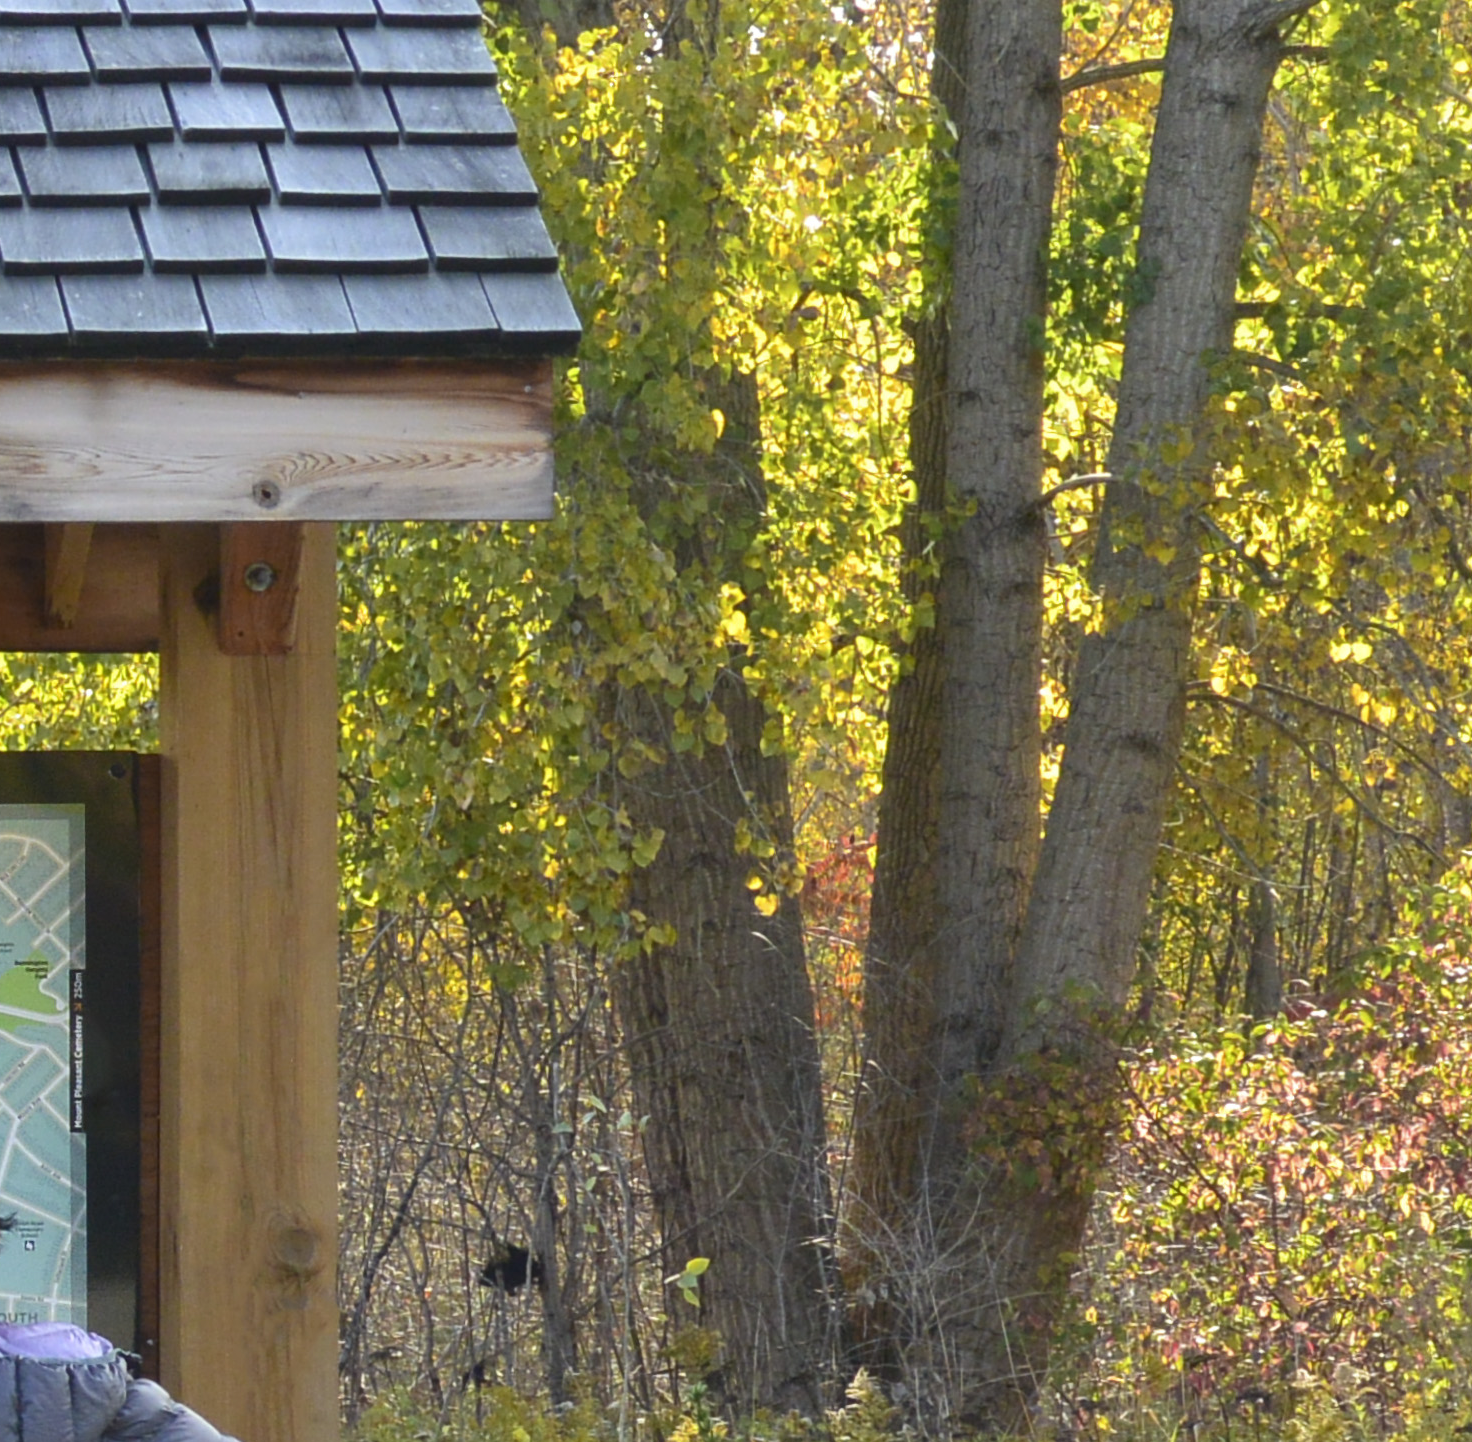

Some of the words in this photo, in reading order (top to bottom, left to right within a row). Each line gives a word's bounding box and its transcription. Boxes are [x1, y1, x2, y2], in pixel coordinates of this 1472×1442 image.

[73, 972, 83, 999] 250m
[74, 1015, 84, 1058] Cemetery
[74, 1061, 83, 1098] Pleasant
[74, 1099, 83, 1128] Mount
